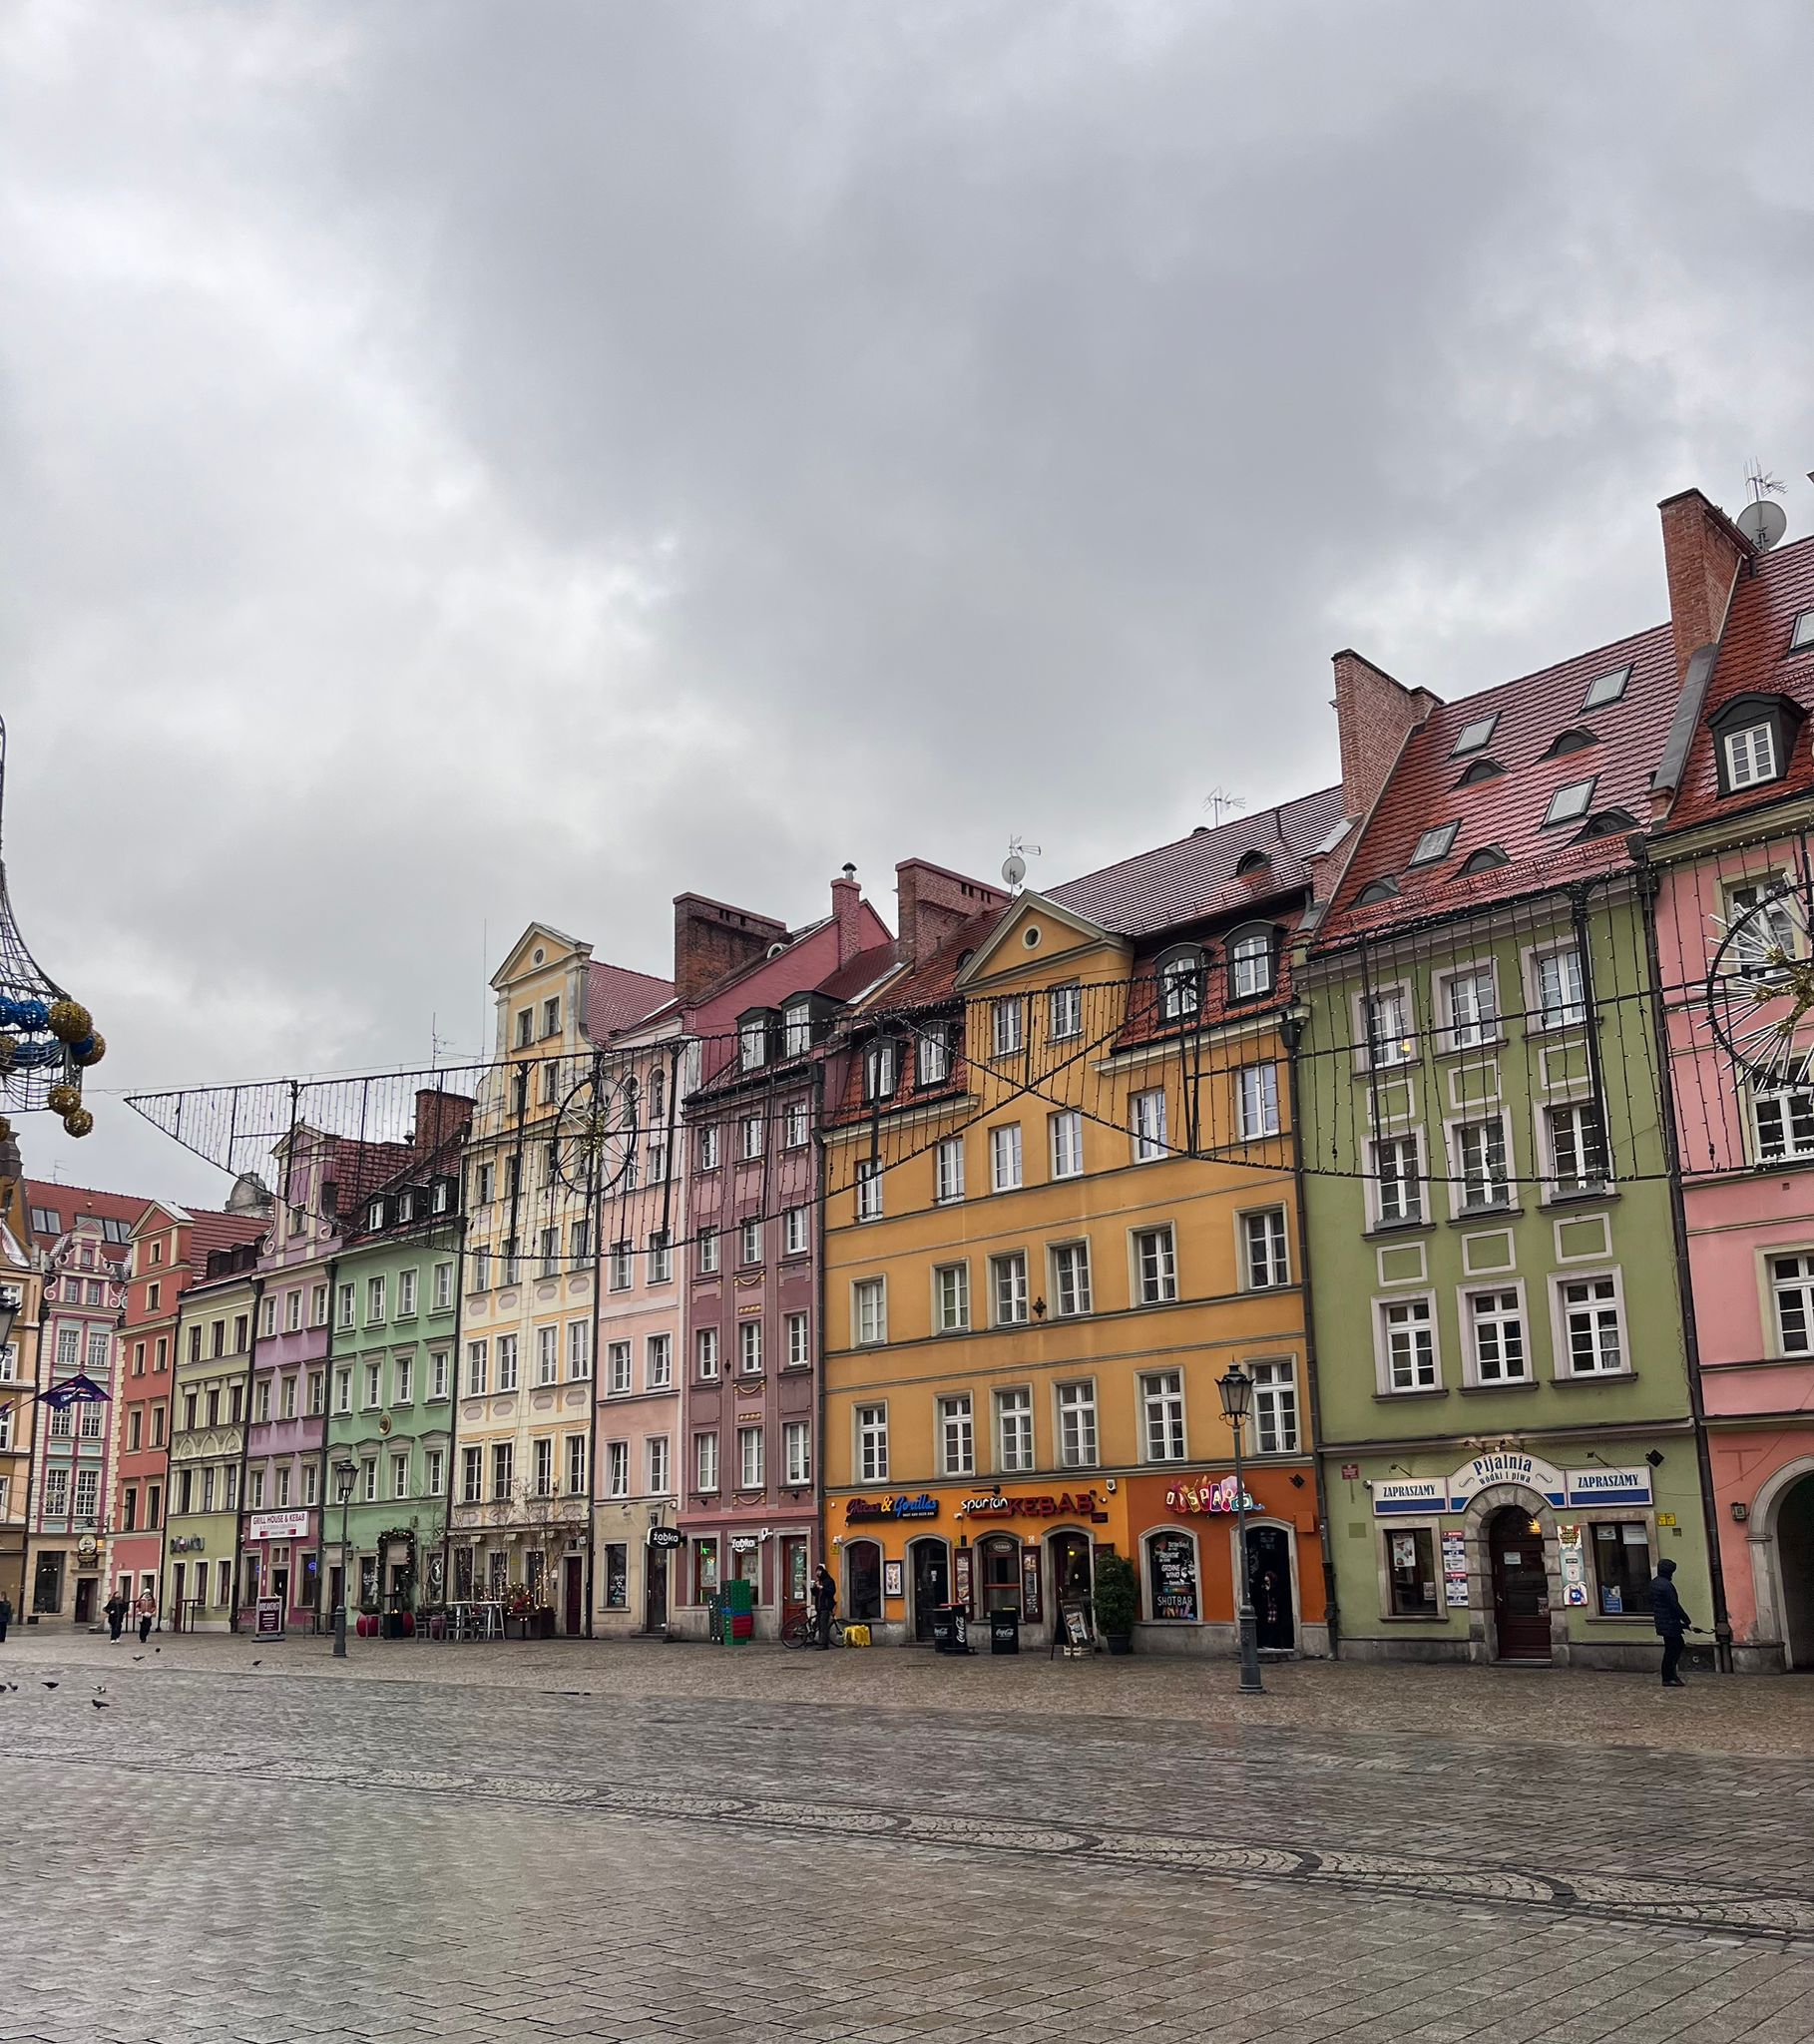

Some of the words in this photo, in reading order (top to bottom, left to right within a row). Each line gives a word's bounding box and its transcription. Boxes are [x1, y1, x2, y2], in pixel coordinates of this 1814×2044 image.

[1473, 1454, 1532, 1475] Pijalnia
[1512, 1472, 1531, 1483] piwa
[1578, 1474, 1638, 1488] ZAPRASZAMY
[1383, 1484, 1435, 1497] ZAPRASZAMY
[881, 1496, 893, 1512] &
[894, 1494, 939, 1517] Gorillas
[961, 1497, 1008, 1511] spartan
[1008, 1493, 1096, 1516] KEBAB
[267, 1514, 284, 1523] HOUSE
[289, 1513, 305, 1522] KEBAB
[653, 1532, 680, 1544] żabka
